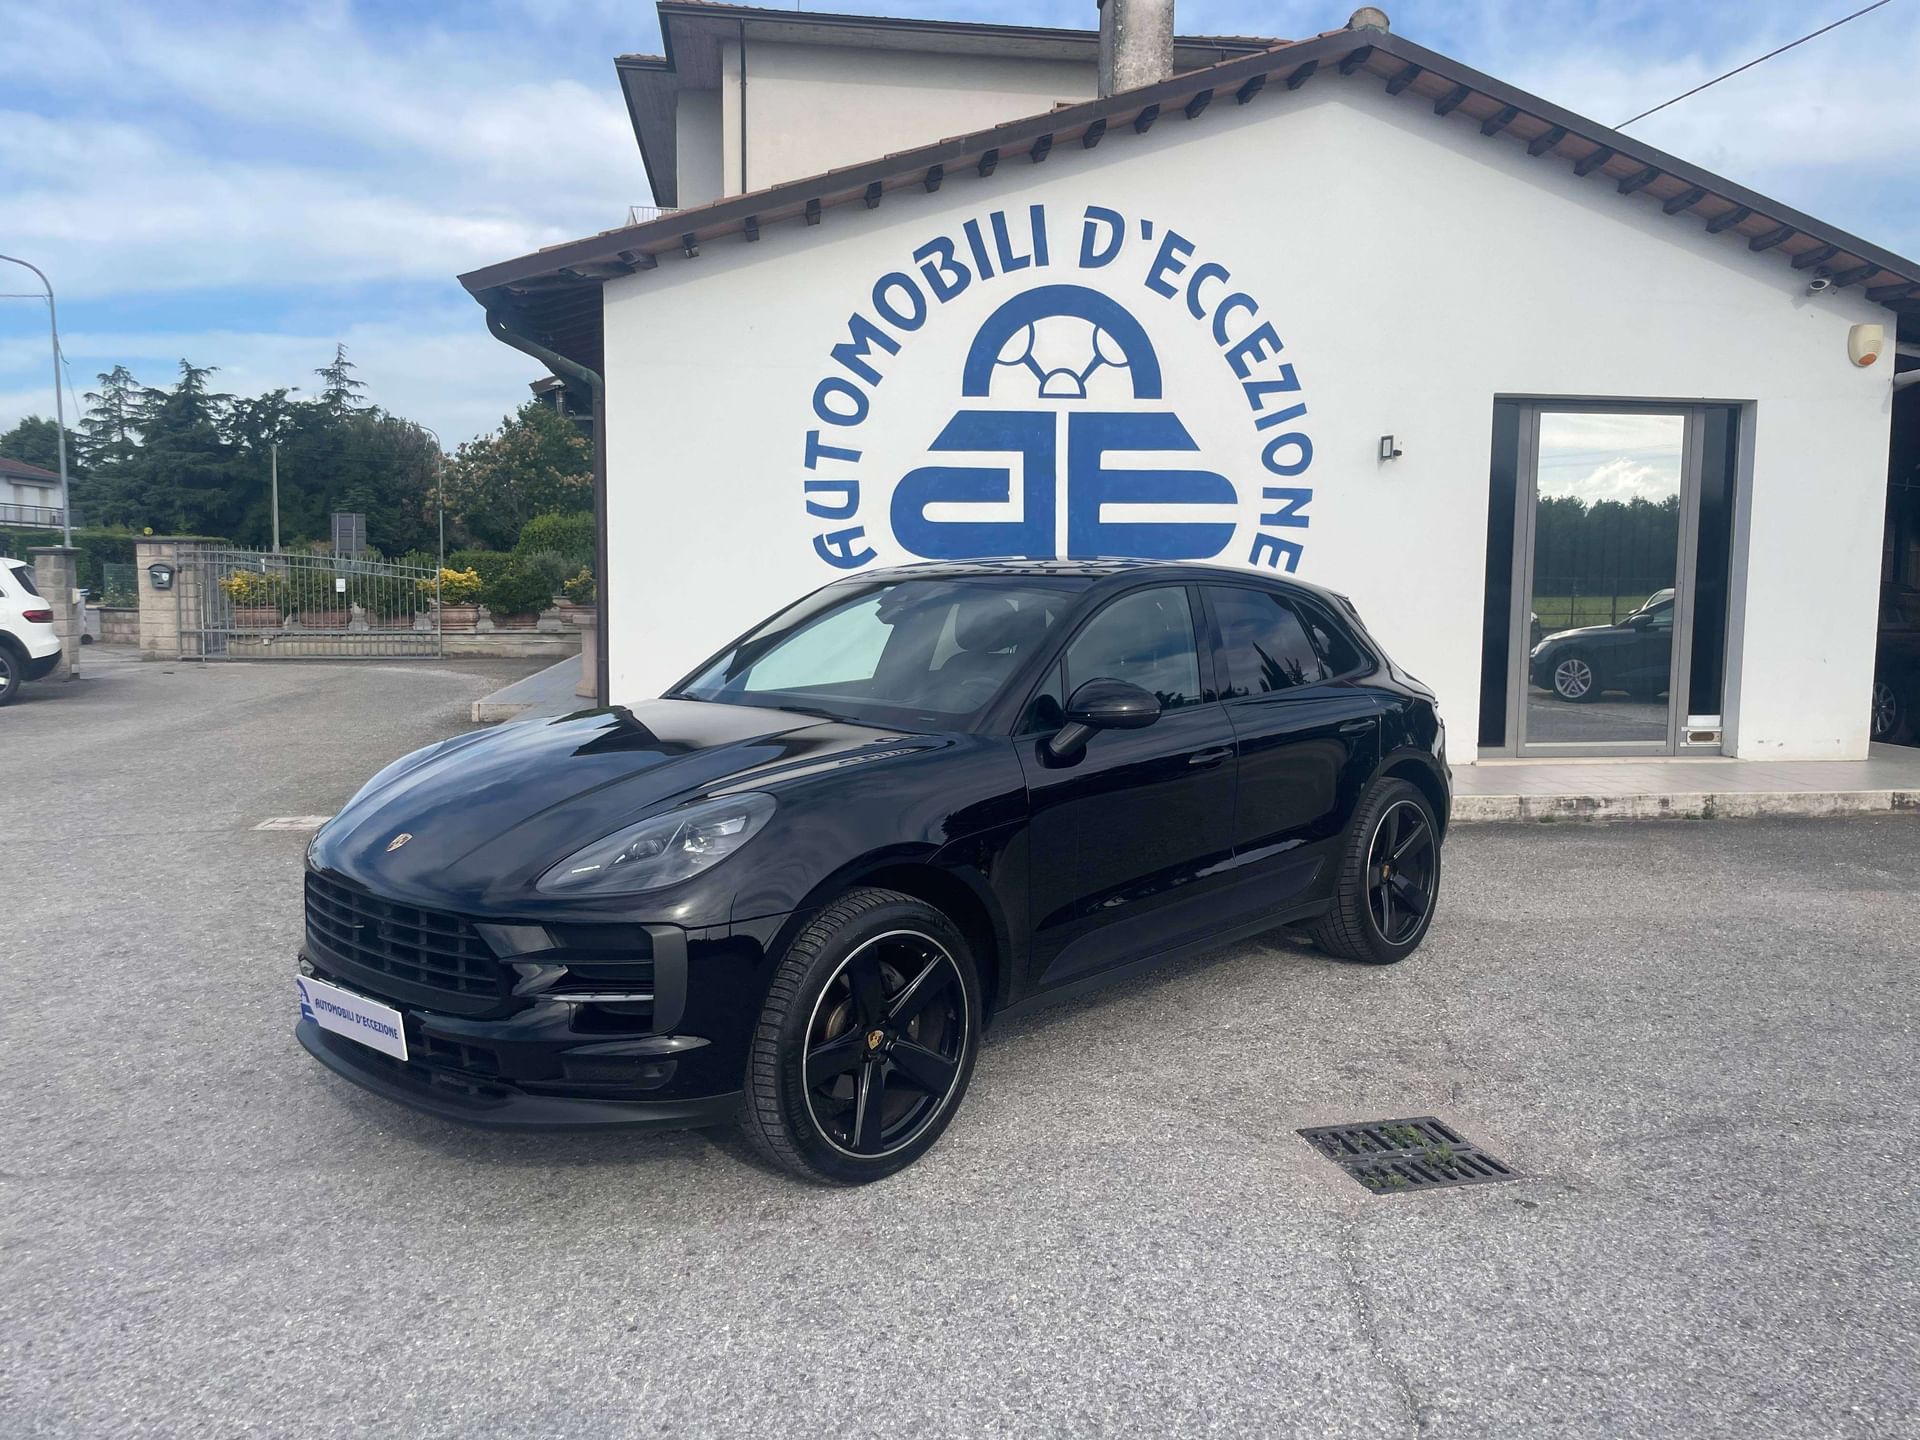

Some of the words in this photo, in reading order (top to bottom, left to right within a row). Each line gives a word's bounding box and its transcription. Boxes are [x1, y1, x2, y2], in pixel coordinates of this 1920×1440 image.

[804, 204, 1049, 569] AUTOMOBILI
[1079, 205, 1314, 574] D'ECCEZIONE
[315, 998, 355, 1022] AUTOMOBILI
[356, 1012, 399, 1040] D'ECCEZIONE
